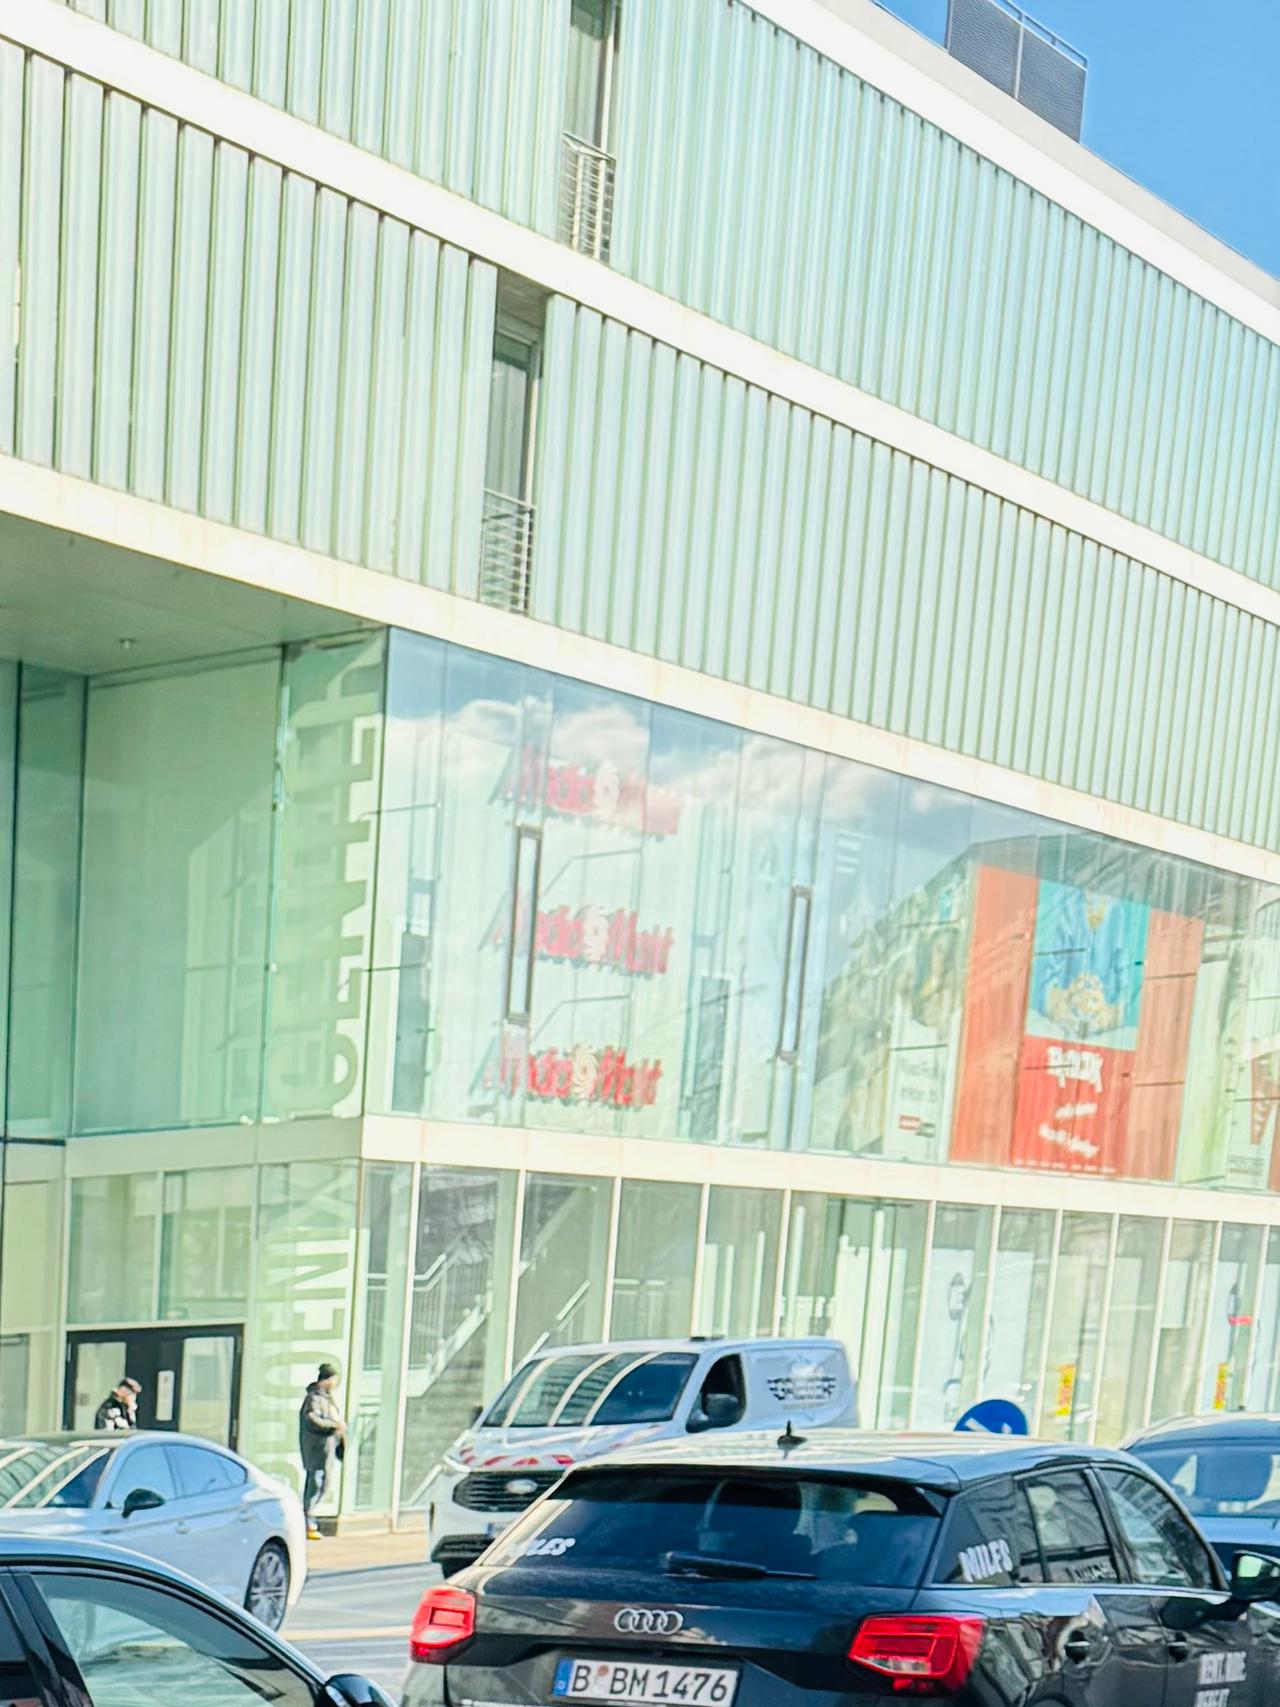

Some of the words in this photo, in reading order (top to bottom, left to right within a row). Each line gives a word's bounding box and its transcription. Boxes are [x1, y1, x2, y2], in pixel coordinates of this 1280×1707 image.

[571, 1665, 592, 1692] B
[609, 1667, 650, 1697] BM
[653, 1669, 728, 1702] 1476
